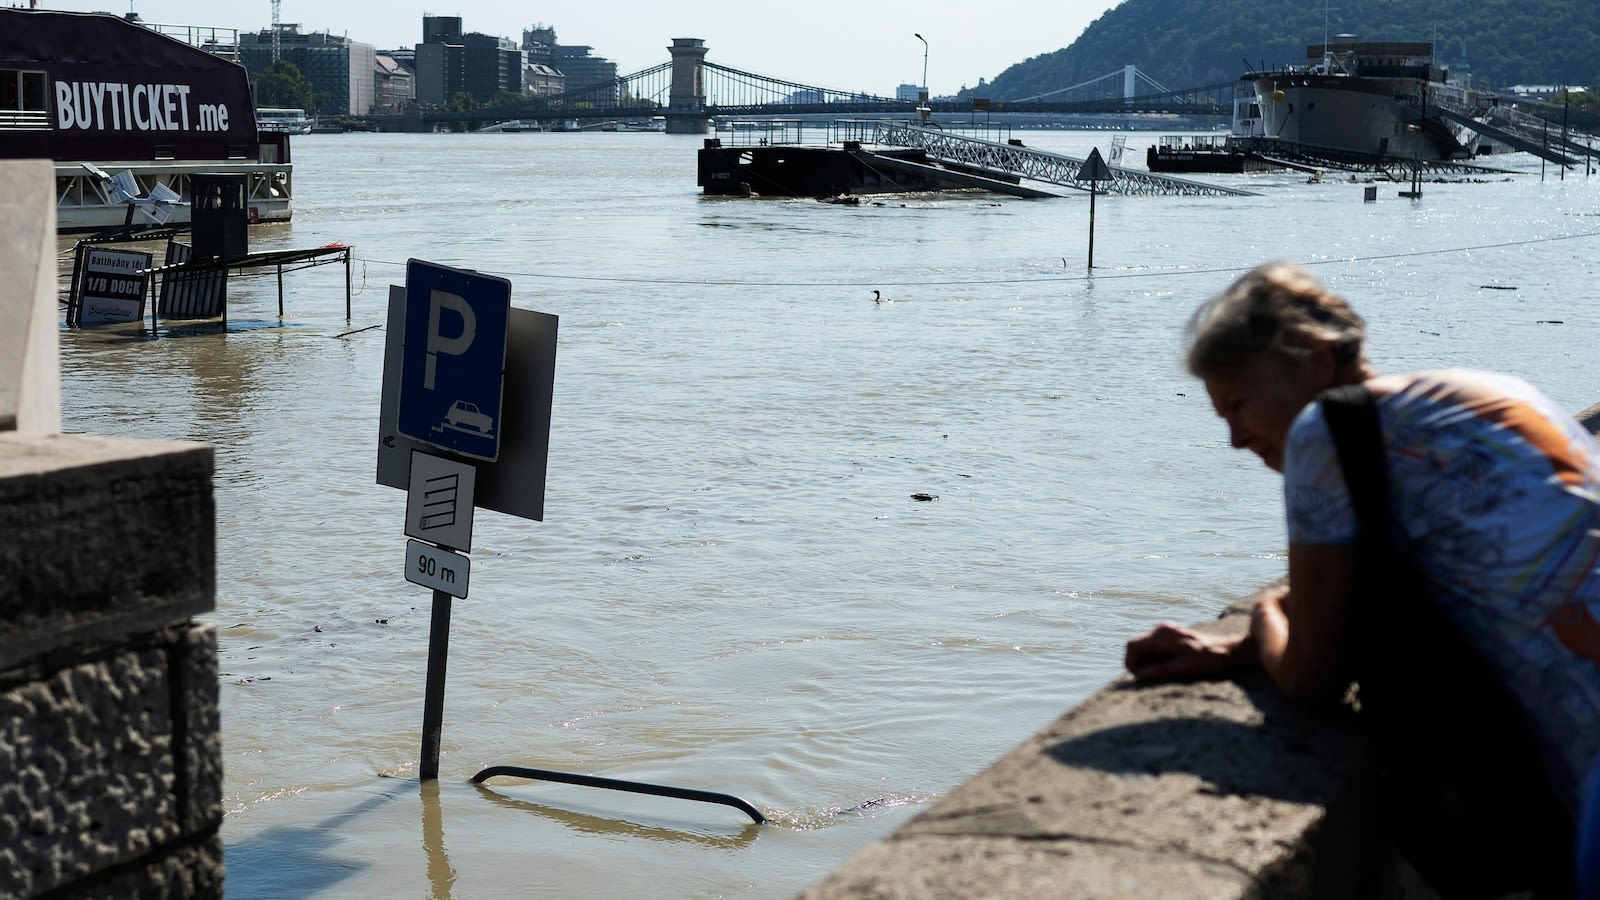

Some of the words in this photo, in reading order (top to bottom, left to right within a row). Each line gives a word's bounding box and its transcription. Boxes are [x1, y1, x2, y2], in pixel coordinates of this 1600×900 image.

[55, 81, 191, 131] BUYTICKET
[195, 103, 229, 132] .me
[91, 256, 130, 270] Batthyány
[132, 258, 143, 269] tér
[88, 277, 107, 293] 1/B
[110, 279, 142, 296] DOCK
[423, 288, 477, 391] P
[418, 554, 436, 577] 90
[440, 567, 455, 584] m
